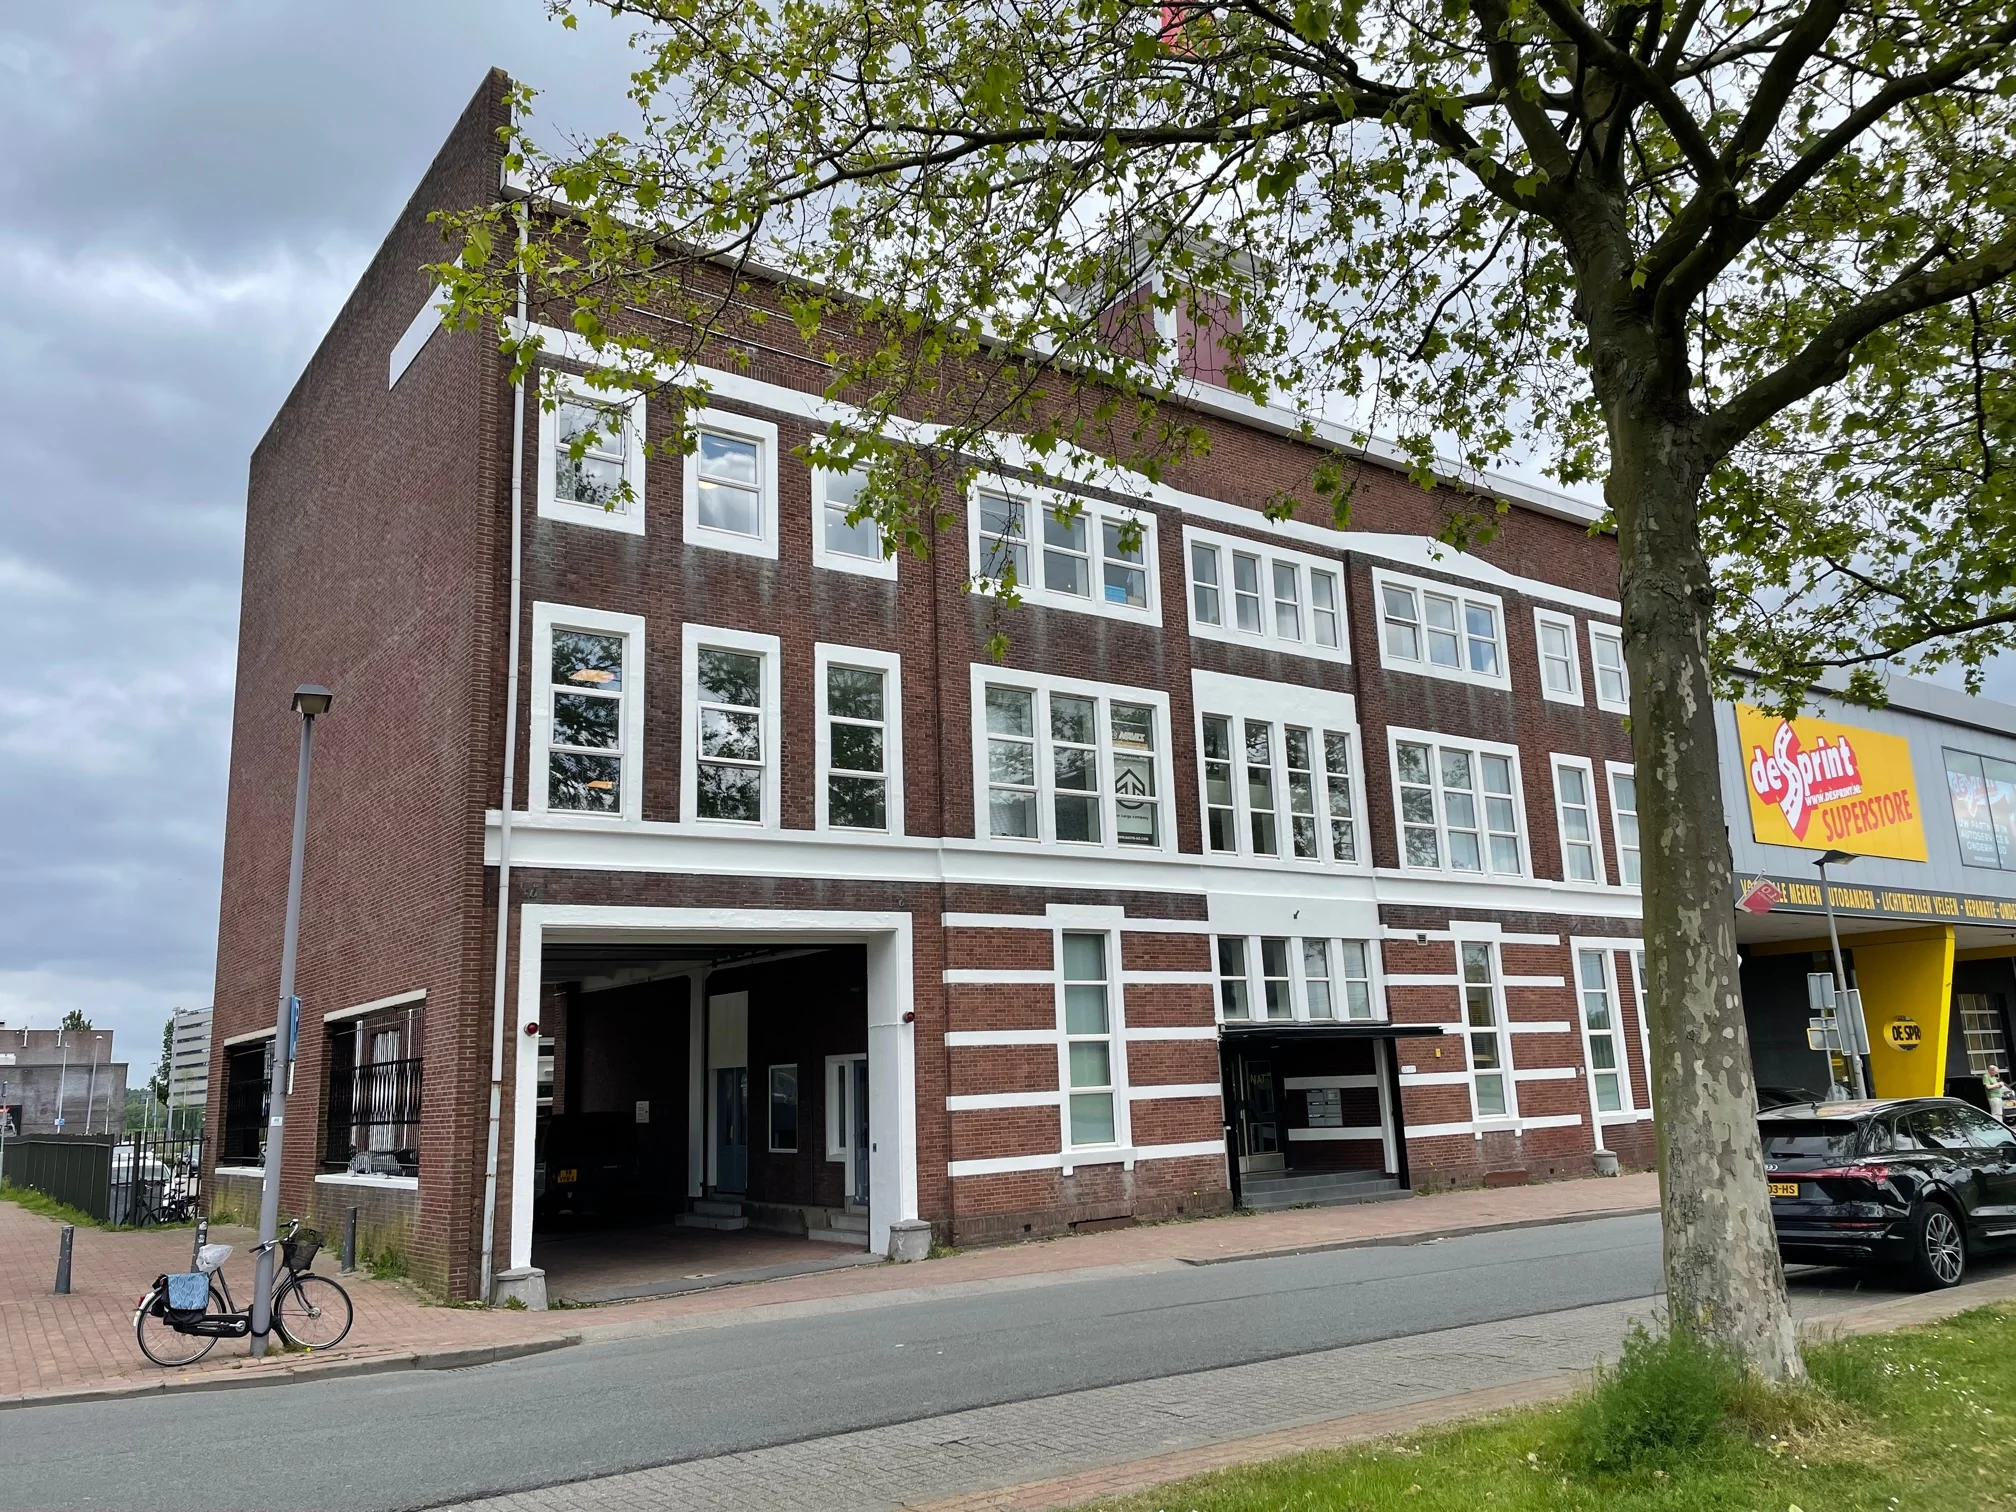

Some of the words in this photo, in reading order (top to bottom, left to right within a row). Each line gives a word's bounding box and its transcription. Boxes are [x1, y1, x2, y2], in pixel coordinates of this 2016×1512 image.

[1822, 789, 1913, 842] SUPERSTORE
[1971, 820, 2000, 832] PARTNR
[1961, 829, 2004, 844] AUTOSERVCE
[1788, 883, 1823, 905] MERKEN
[1827, 886, 1876, 909] UTOBANDEN
[1880, 891, 1932, 914] LICHTMETALEN
[1932, 896, 1960, 916] VELGEN
